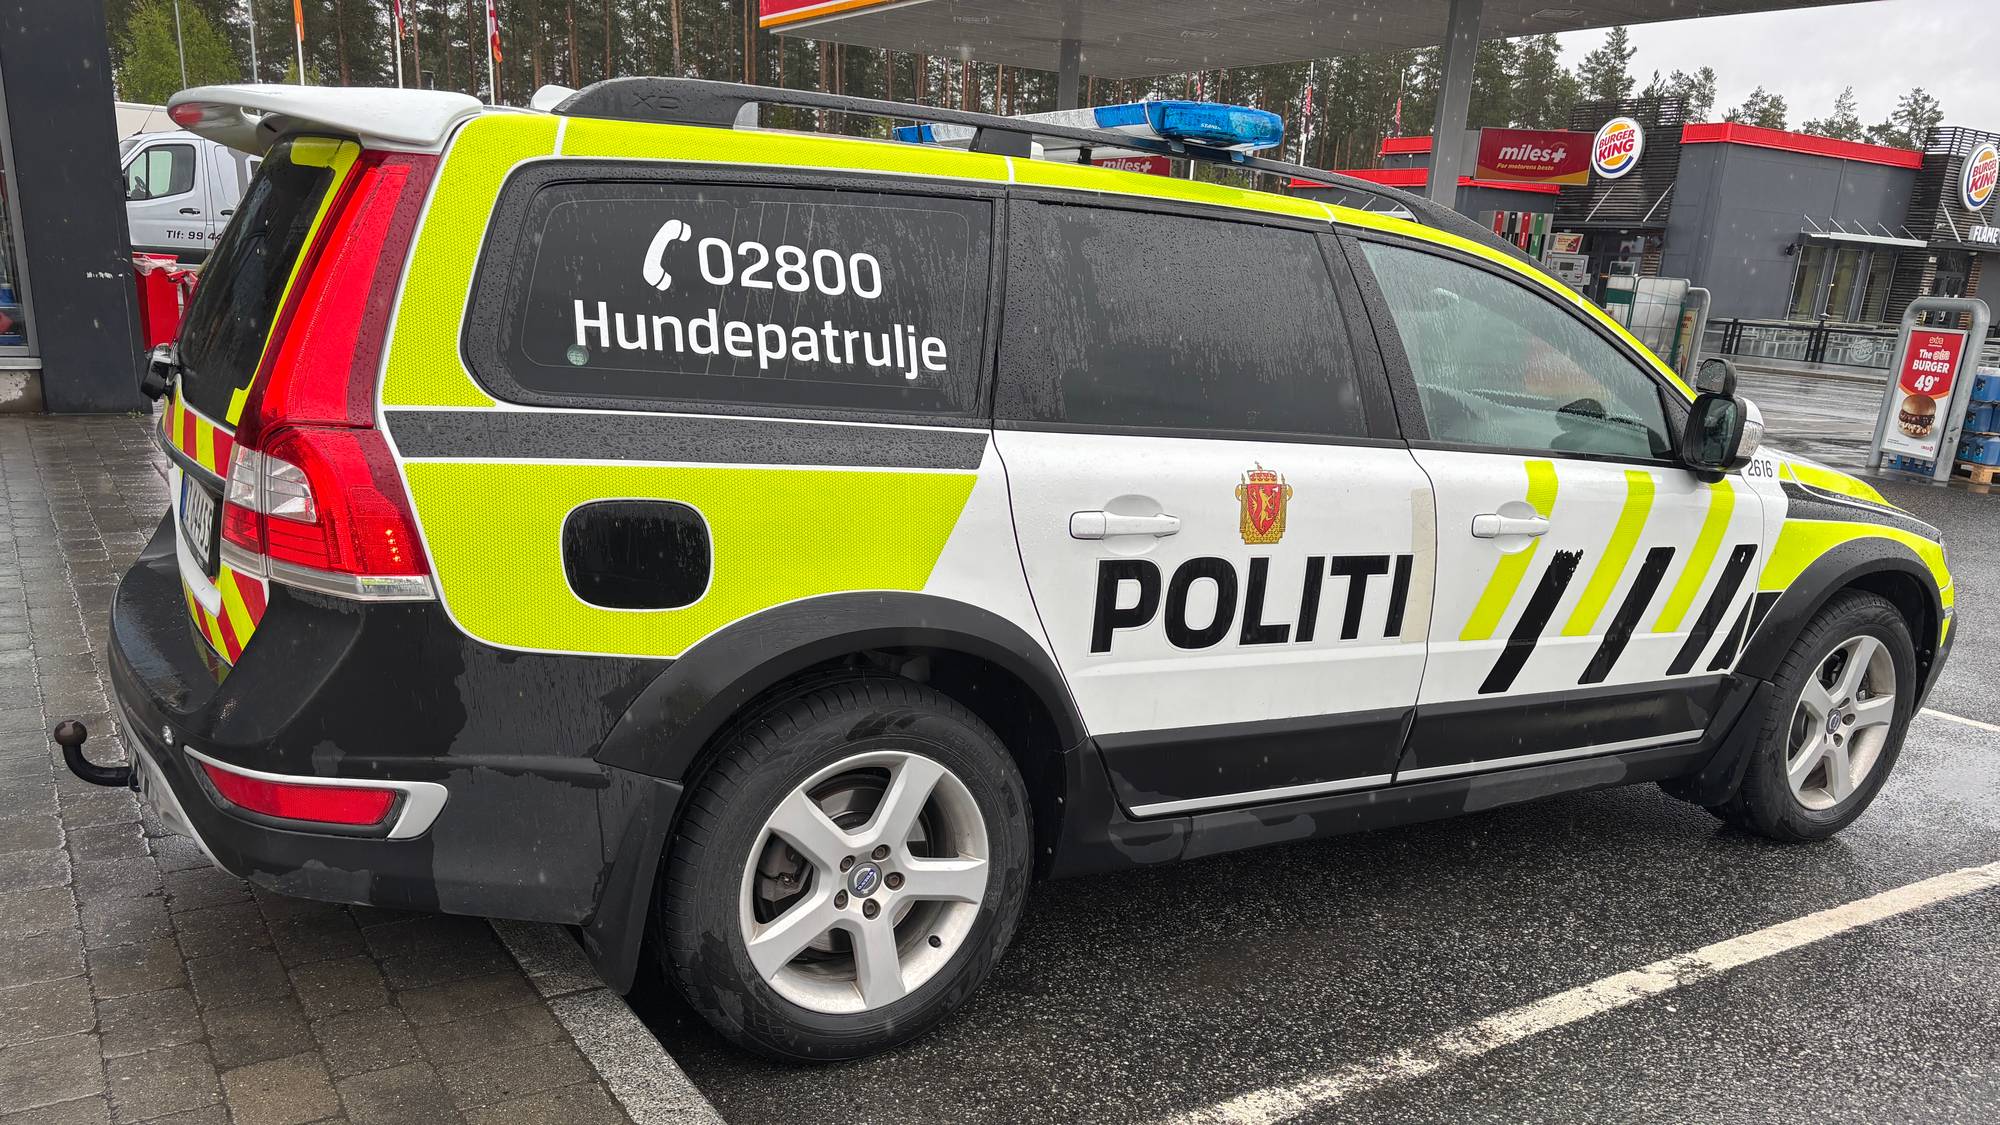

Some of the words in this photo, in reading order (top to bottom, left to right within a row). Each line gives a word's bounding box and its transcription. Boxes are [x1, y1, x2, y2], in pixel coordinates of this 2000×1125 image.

[1599, 129, 1636, 148] BURGER
[1597, 139, 1635, 162] KING
[1969, 170, 1997, 192] KING
[166, 230, 184, 239] Tlf:
[188, 231, 204, 240] 99
[698, 237, 883, 299] 02800
[573, 299, 947, 380] Hundepatrulje
[1919, 349, 1933, 359] The
[1912, 359, 1950, 374] BURGER
[1748, 459, 1773, 478] 2616
[1090, 554, 1414, 653] POLITI
